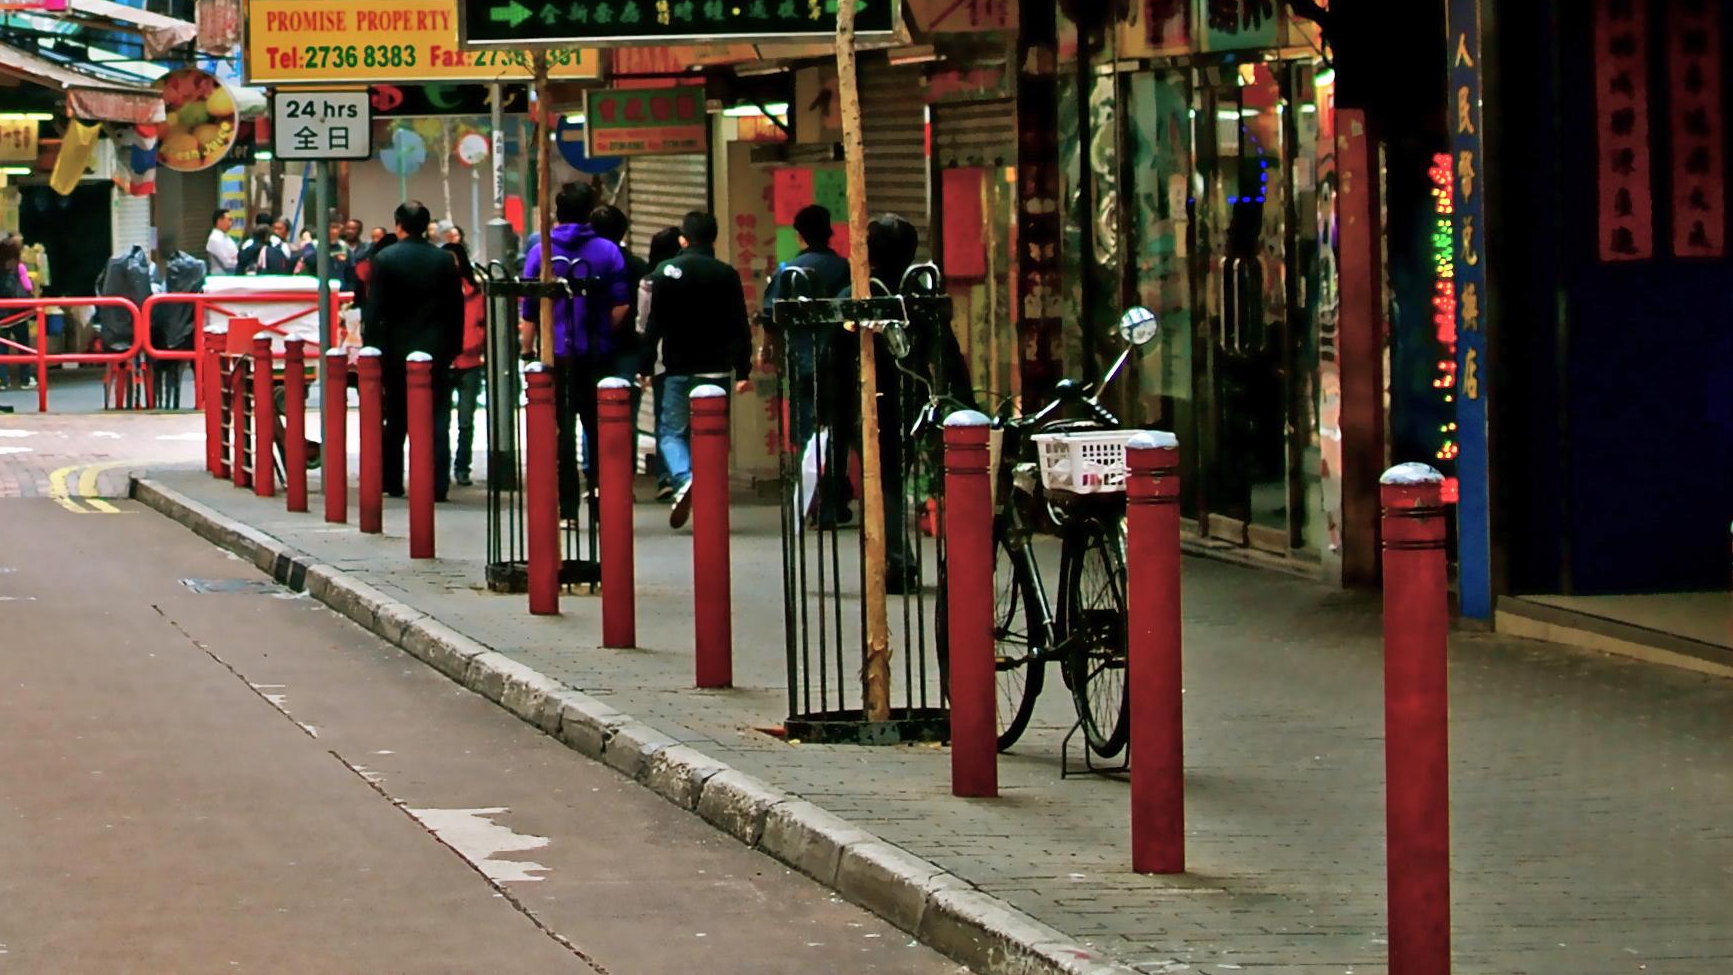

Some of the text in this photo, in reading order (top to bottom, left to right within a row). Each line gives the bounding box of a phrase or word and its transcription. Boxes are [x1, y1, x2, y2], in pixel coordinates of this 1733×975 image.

[267, 8, 451, 33] PROMISE PROPERTY
[363, 44, 417, 68] 8383
[286, 100, 358, 118] 24 hrs
[293, 126, 349, 151] 全日
